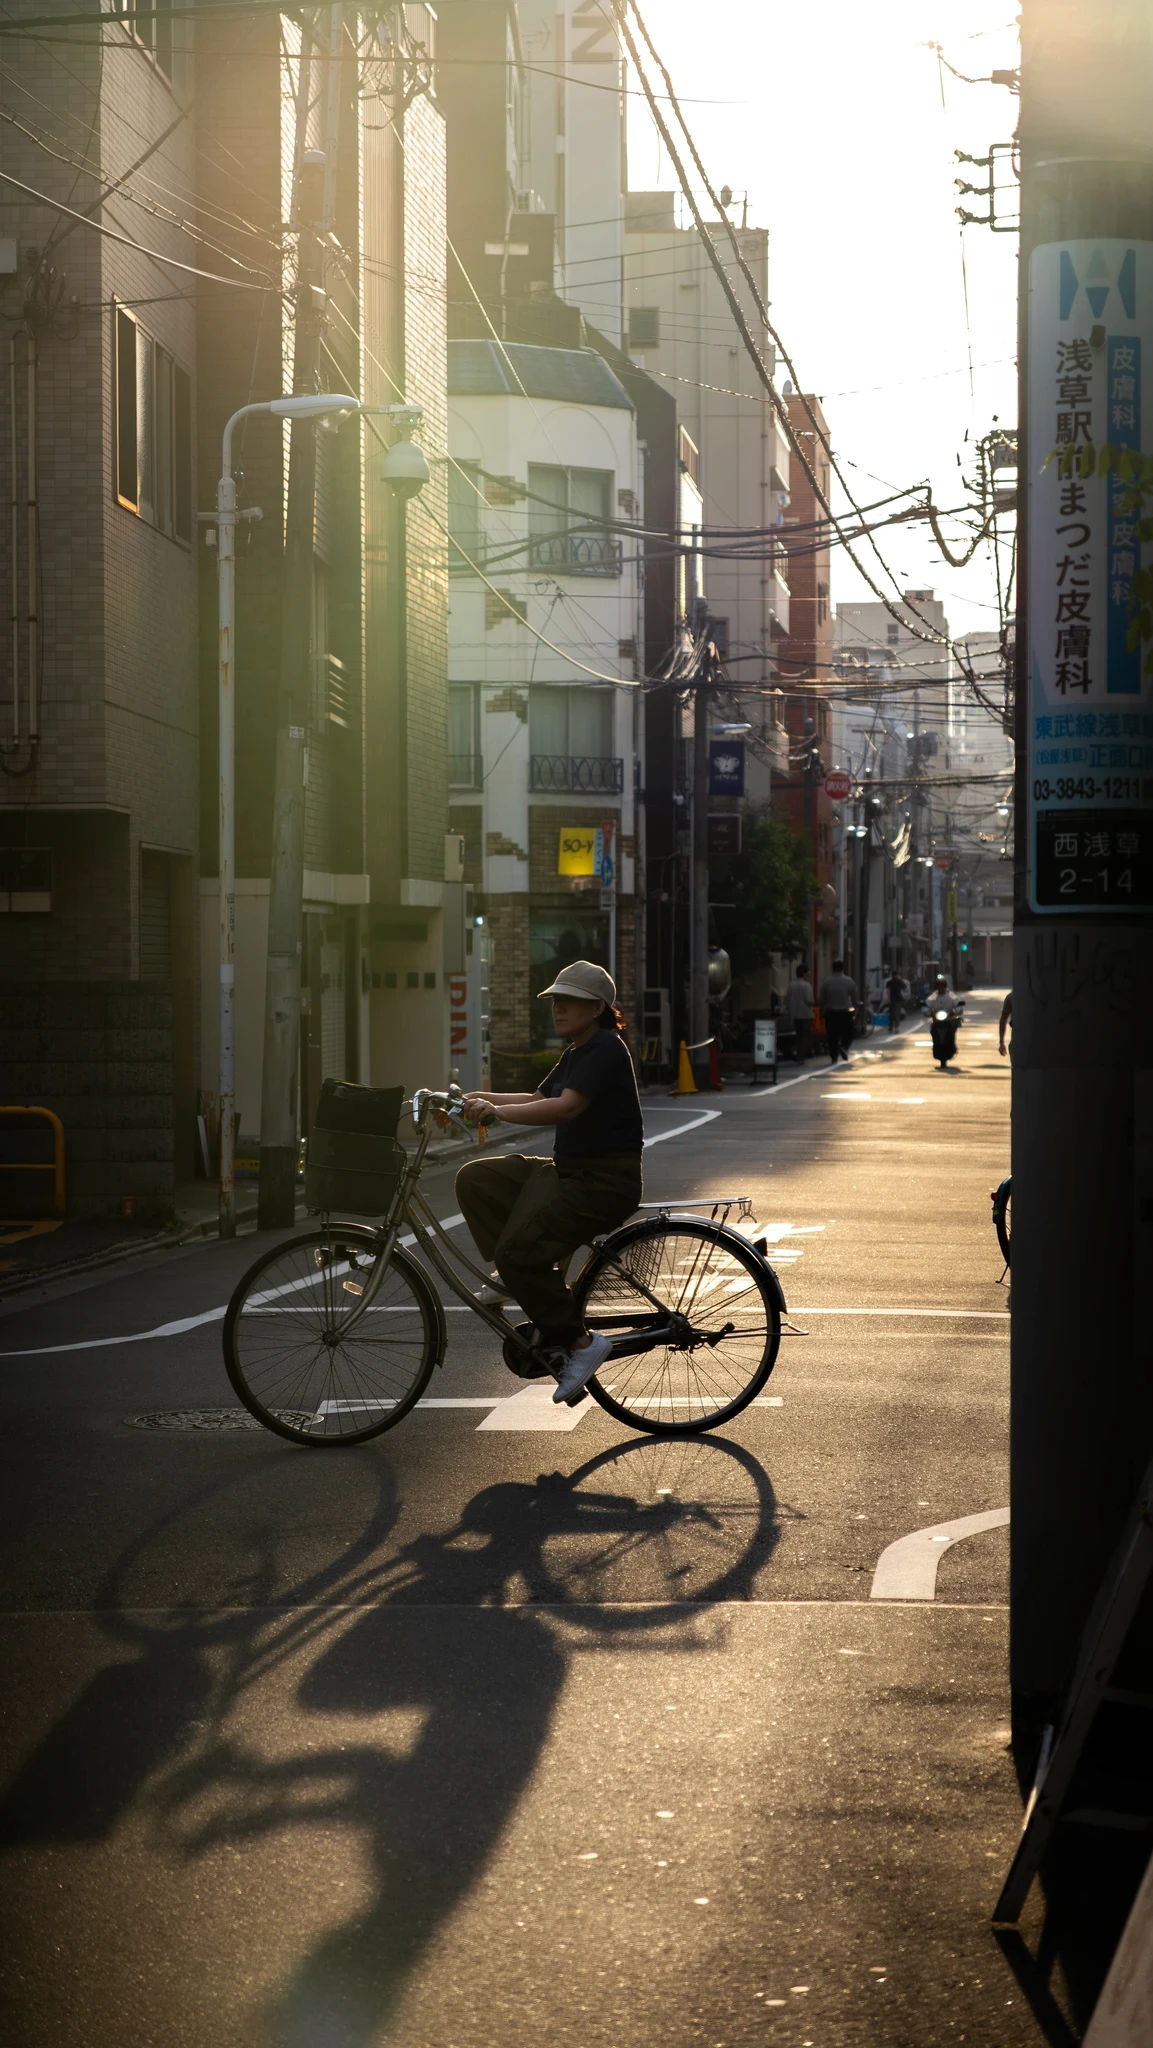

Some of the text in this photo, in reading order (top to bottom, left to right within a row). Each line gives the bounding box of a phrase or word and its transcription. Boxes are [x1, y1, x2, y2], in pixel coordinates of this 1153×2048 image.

[1055, 338, 1093, 695] 浅草駅前まつだ皮膚科
[1033, 777, 1140, 801] 03-3843-1211
[1053, 831, 1142, 860] 西浅草
[1058, 867, 1136, 894] 2-14
